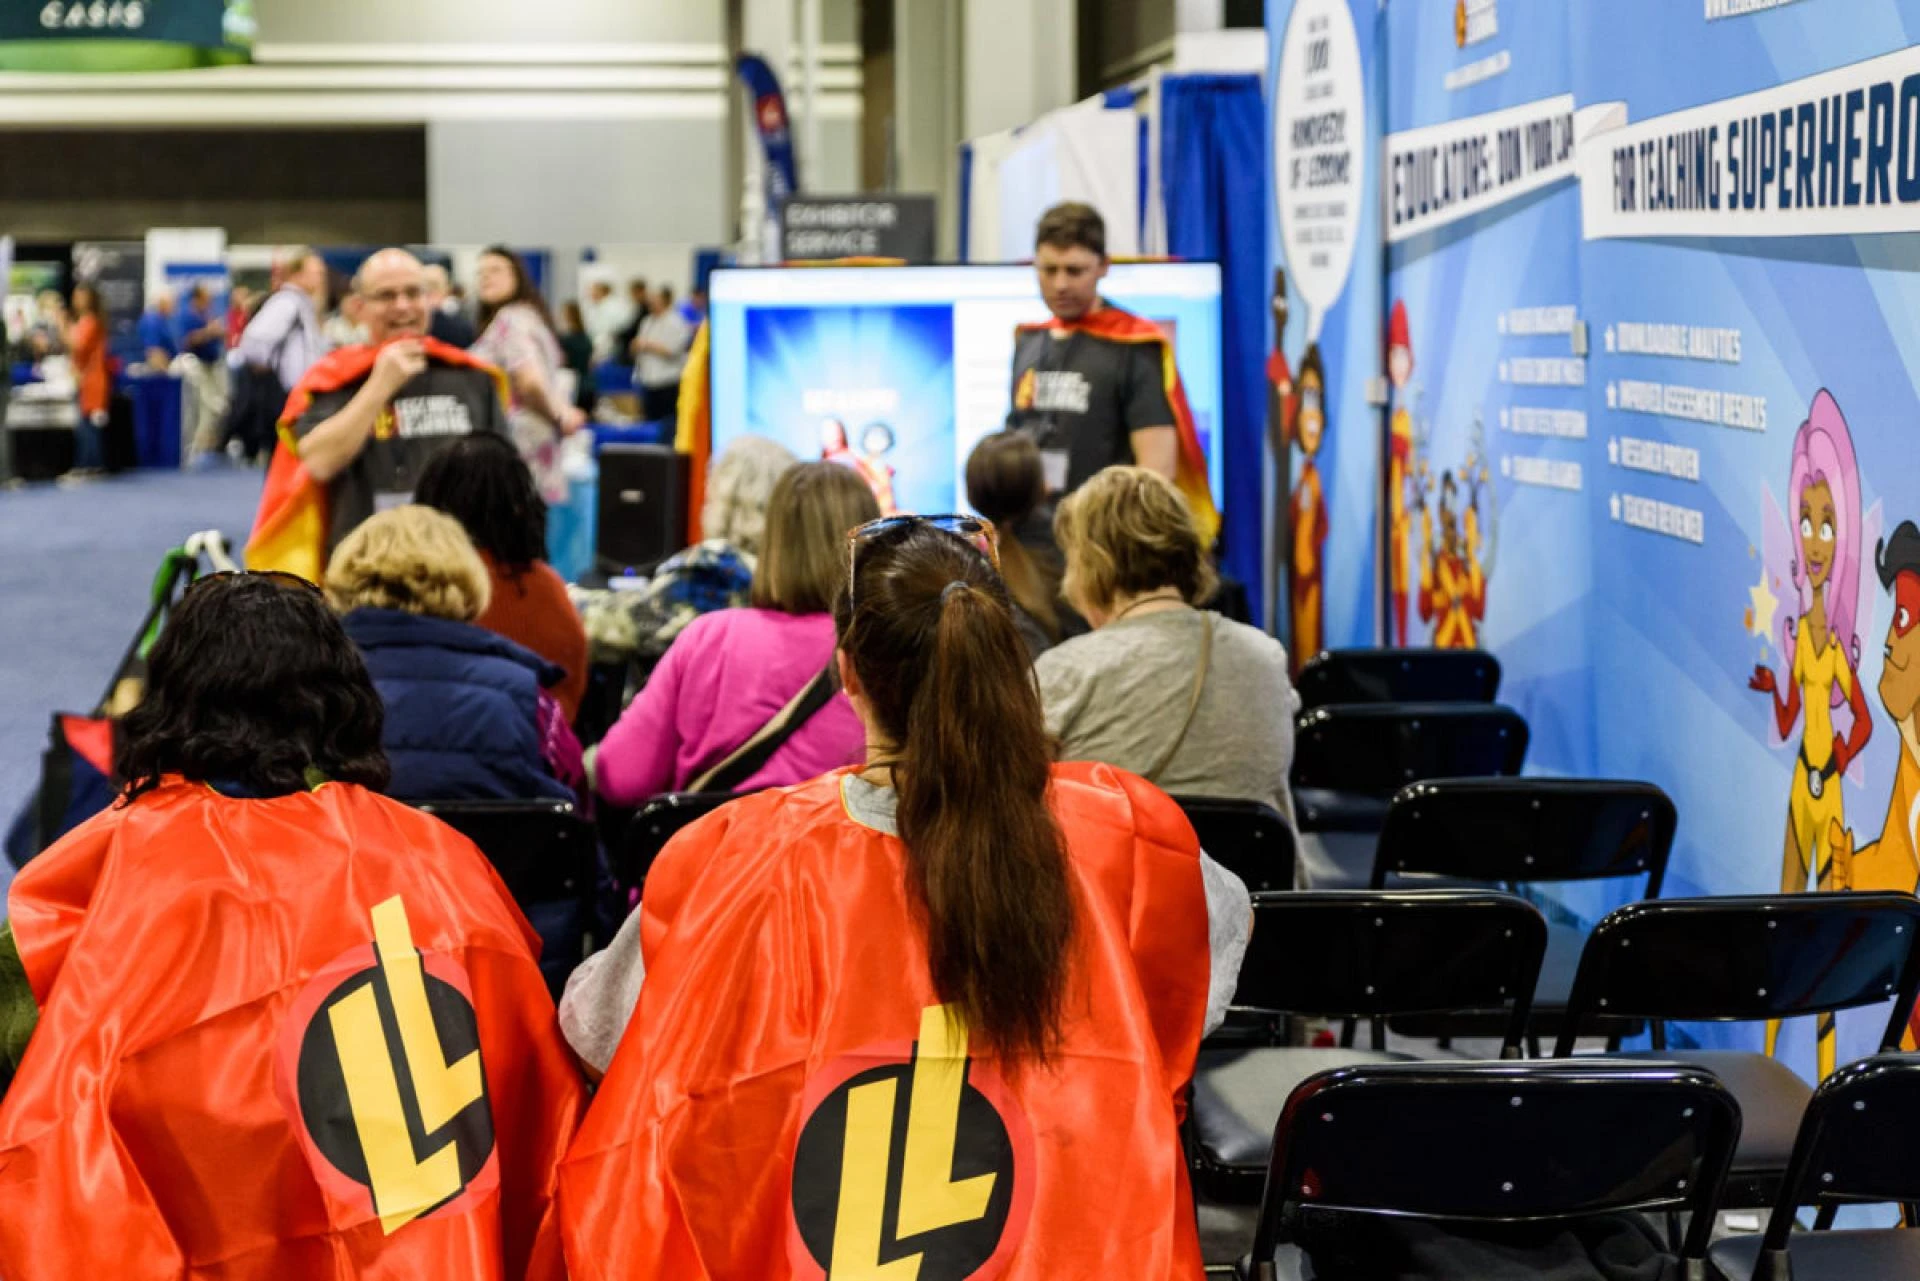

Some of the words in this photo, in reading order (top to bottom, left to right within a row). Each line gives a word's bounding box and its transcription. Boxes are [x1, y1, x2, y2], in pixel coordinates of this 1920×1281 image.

[1613, 145, 1636, 212] FOR
[1640, 125, 1720, 212] TEACHING
[1728, 72, 1920, 211] SUPERHERO
[1722, 393, 1767, 432] RESULTS
